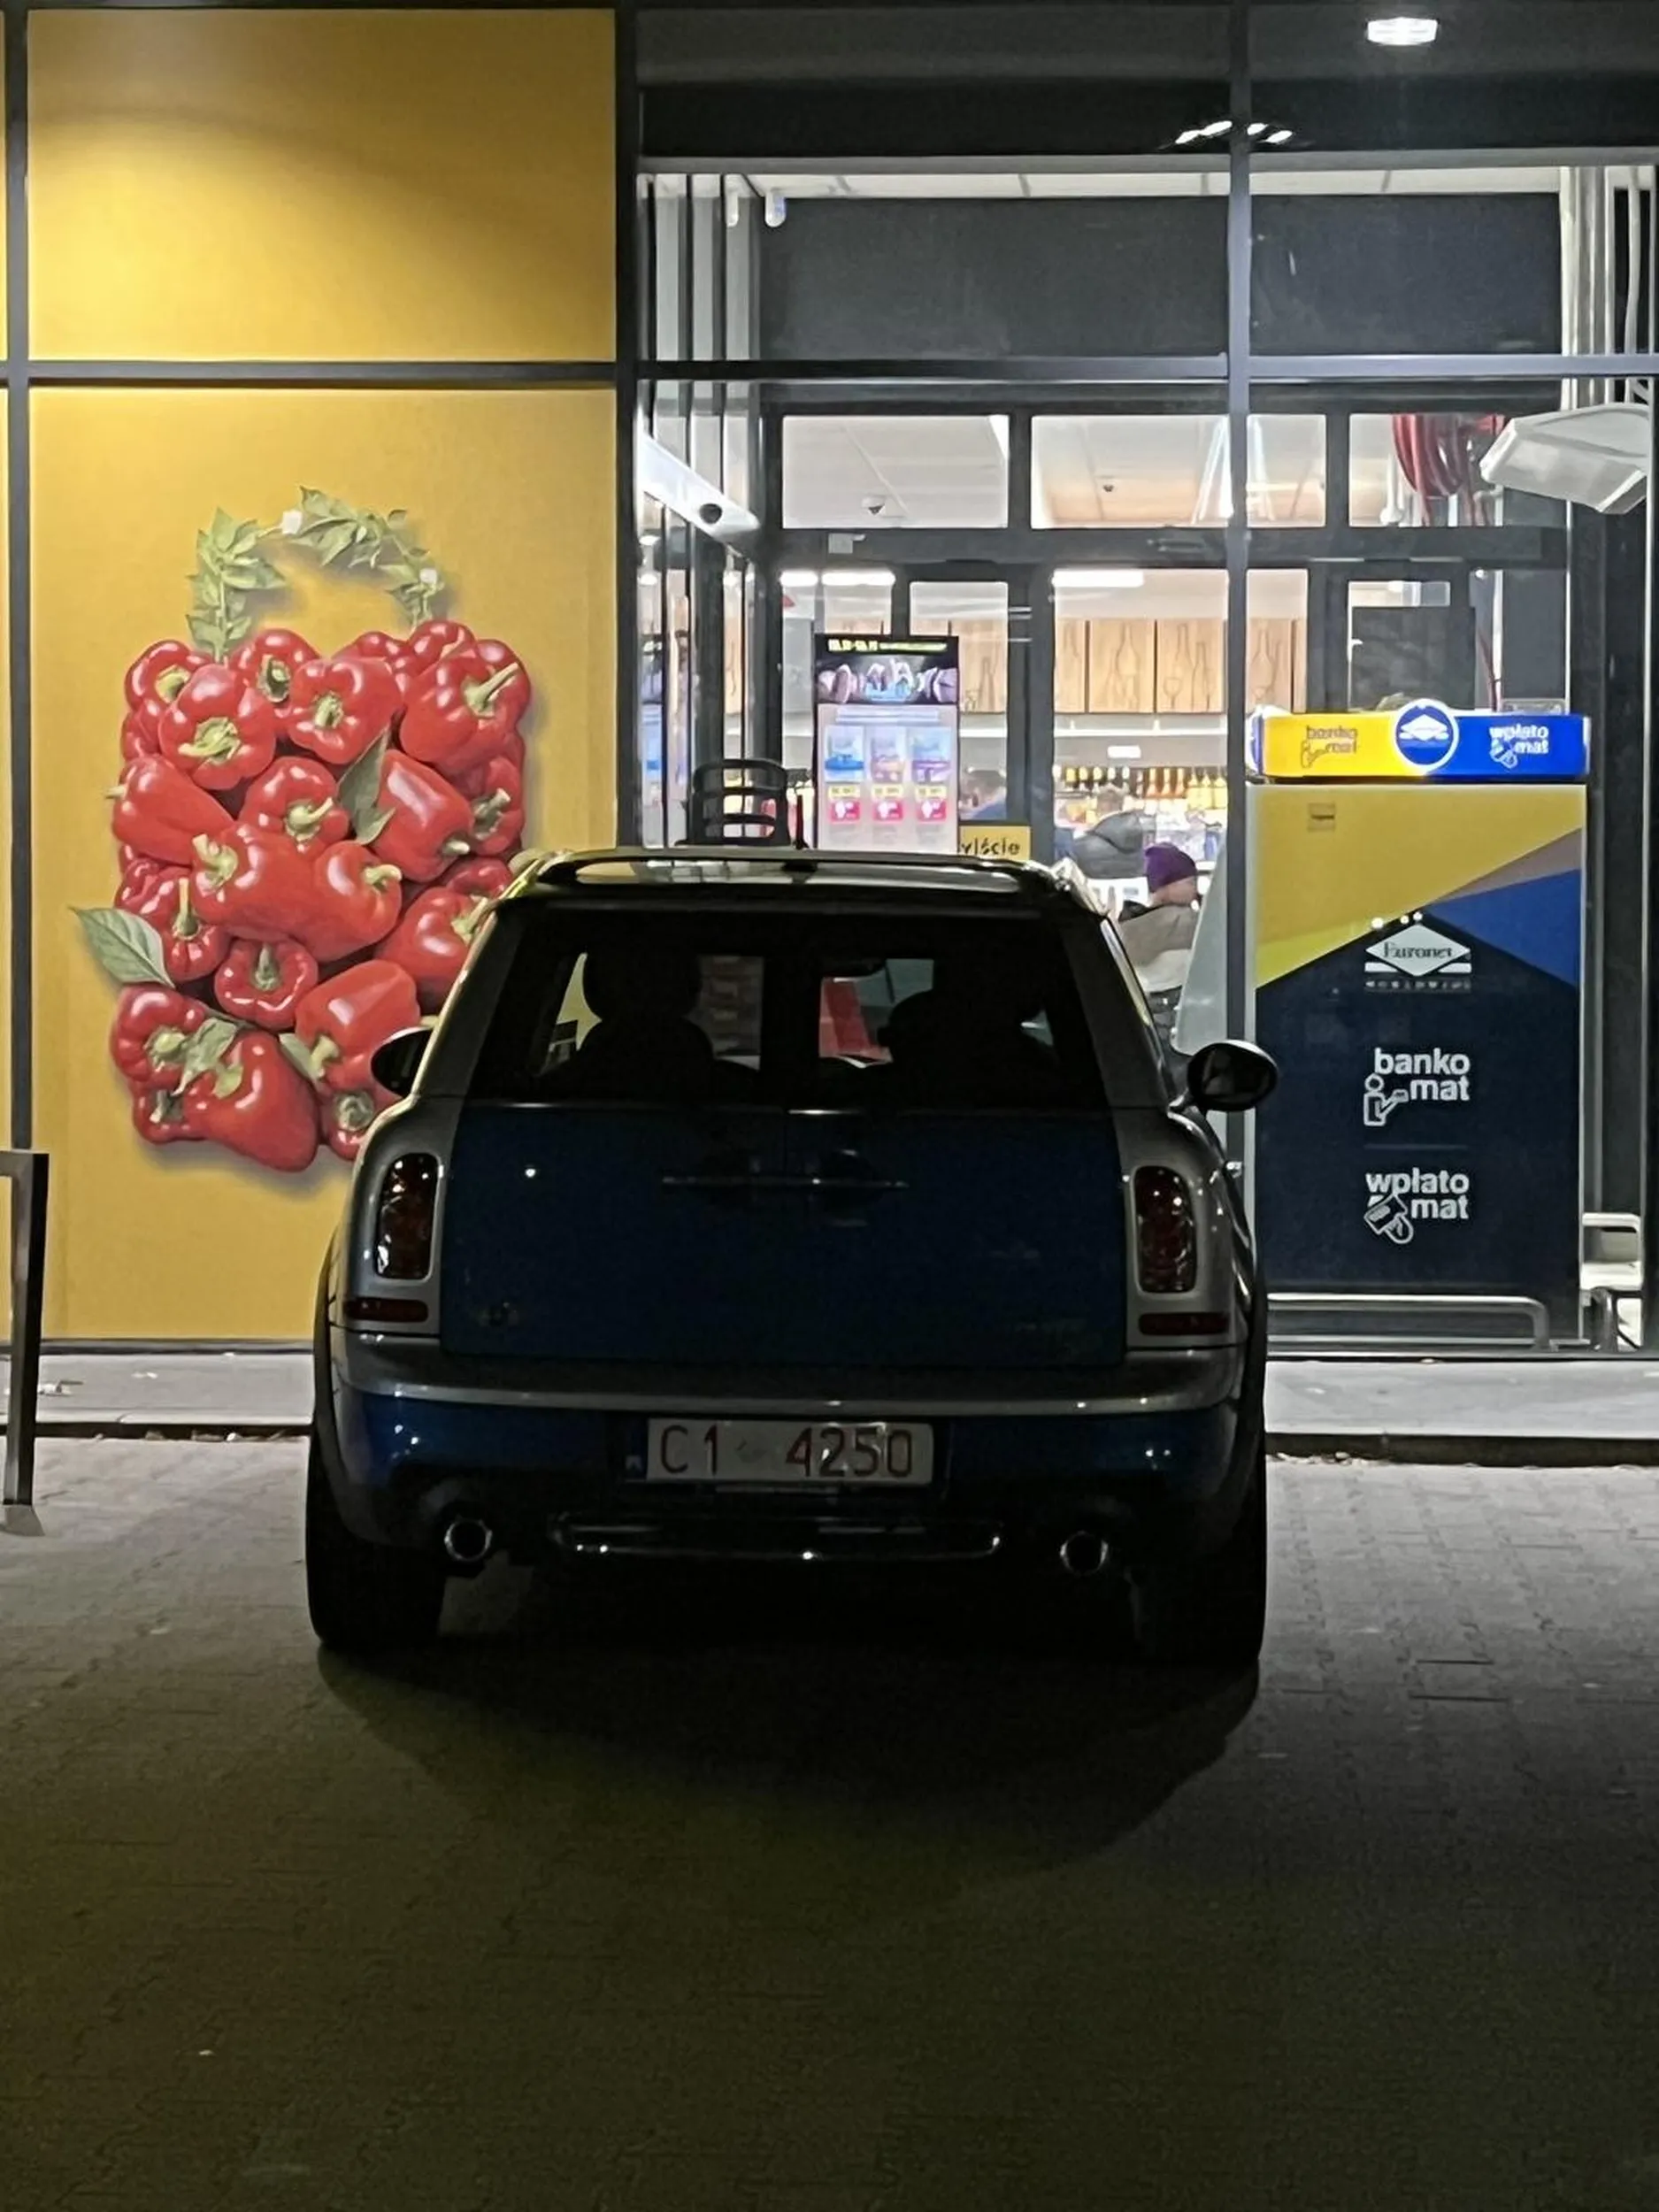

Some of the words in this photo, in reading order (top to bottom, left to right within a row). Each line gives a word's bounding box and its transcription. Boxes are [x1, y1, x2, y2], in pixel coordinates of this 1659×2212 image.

[1382, 941, 1453, 959] Euronet
[1374, 1047, 1471, 1075] banko
[1409, 1075, 1471, 1101] mat
[1410, 1194, 1470, 1219] mat
[660, 1424, 718, 1477] C1
[786, 1426, 913, 1479] 4250
